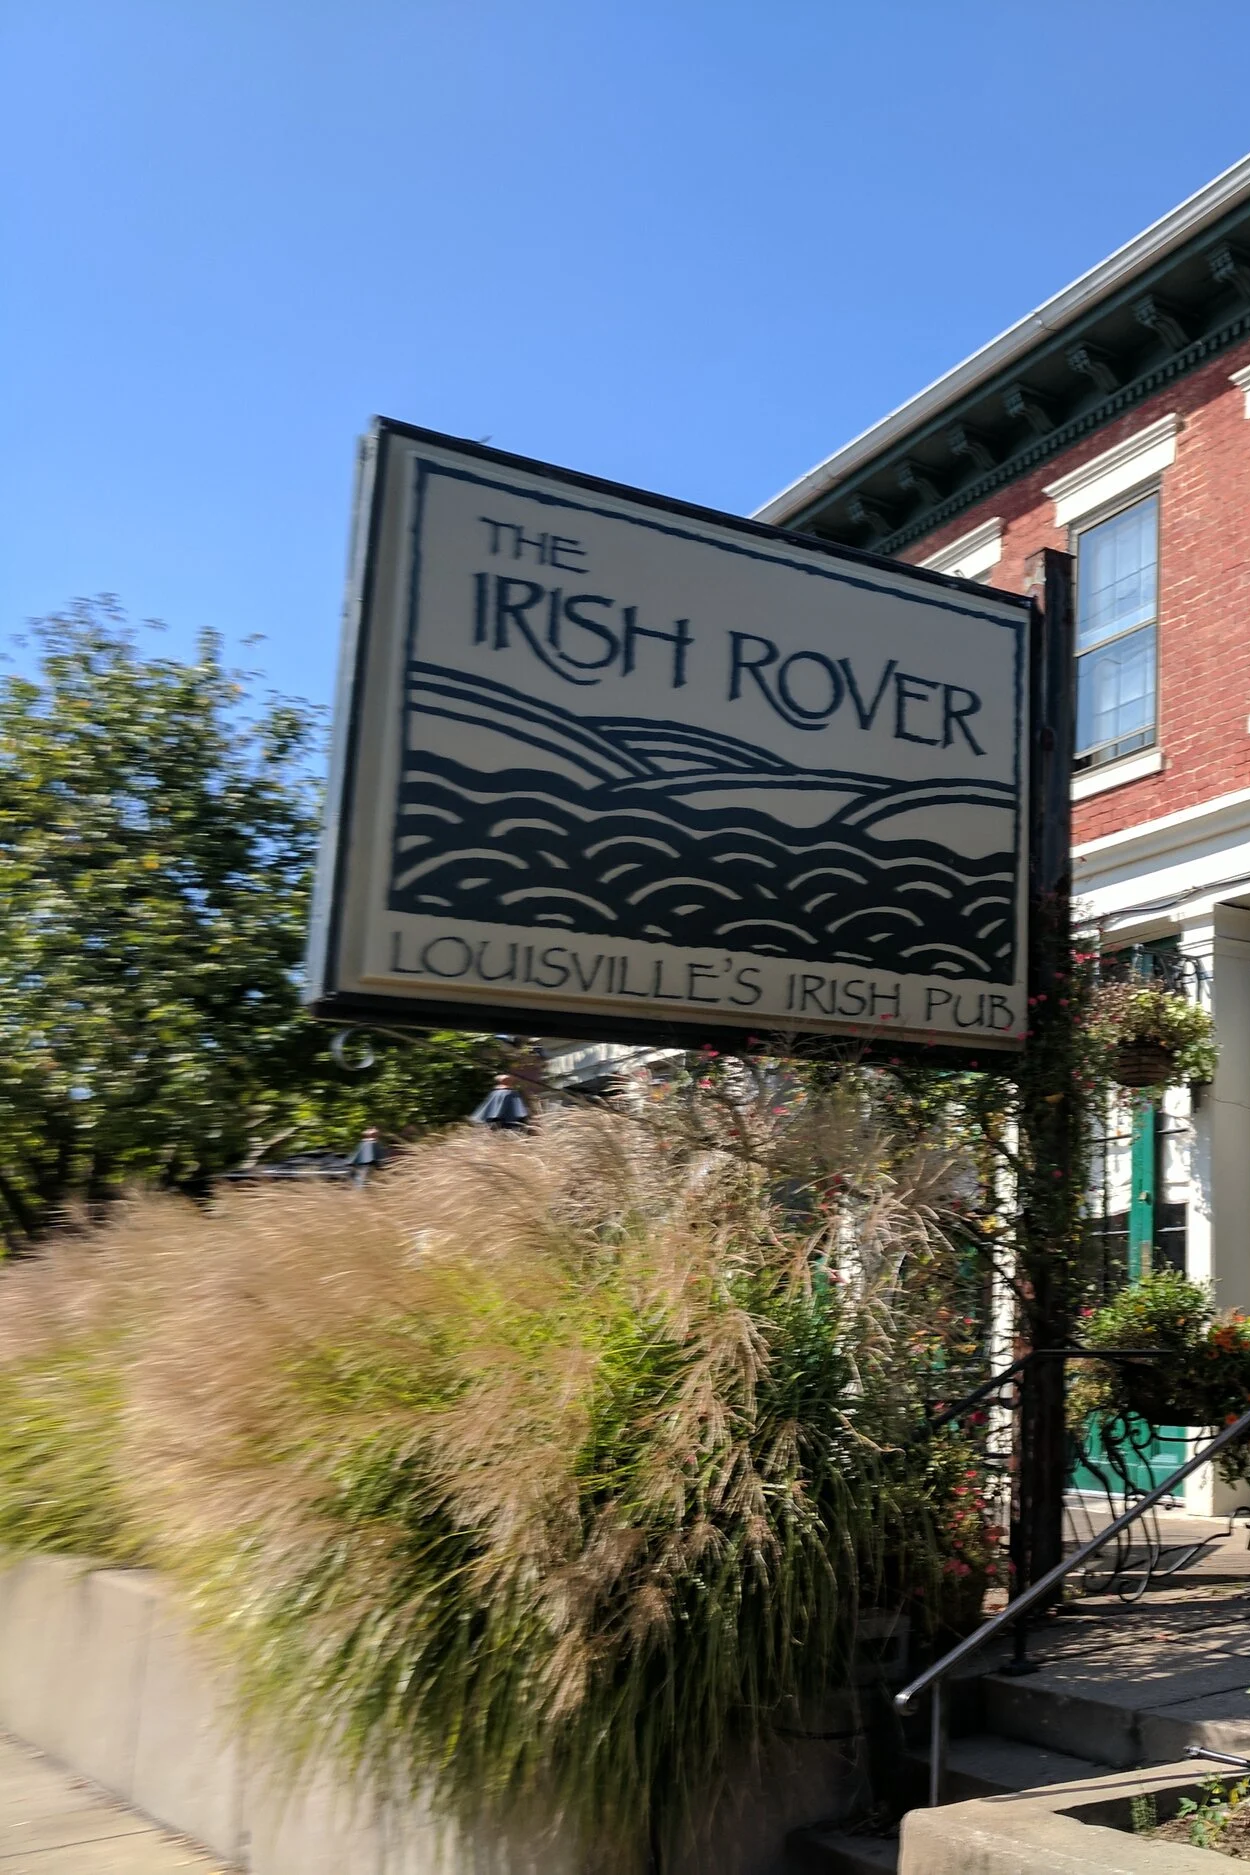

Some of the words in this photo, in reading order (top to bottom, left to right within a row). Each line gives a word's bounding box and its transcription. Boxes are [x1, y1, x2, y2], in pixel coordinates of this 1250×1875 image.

[479, 516, 589, 574] THE
[474, 572, 694, 689] IRISH
[728, 630, 987, 756] ROVER
[389, 930, 763, 1006] LOUISVILLE'S
[785, 973, 901, 1018] IRISH
[925, 987, 1016, 1030] PUB
